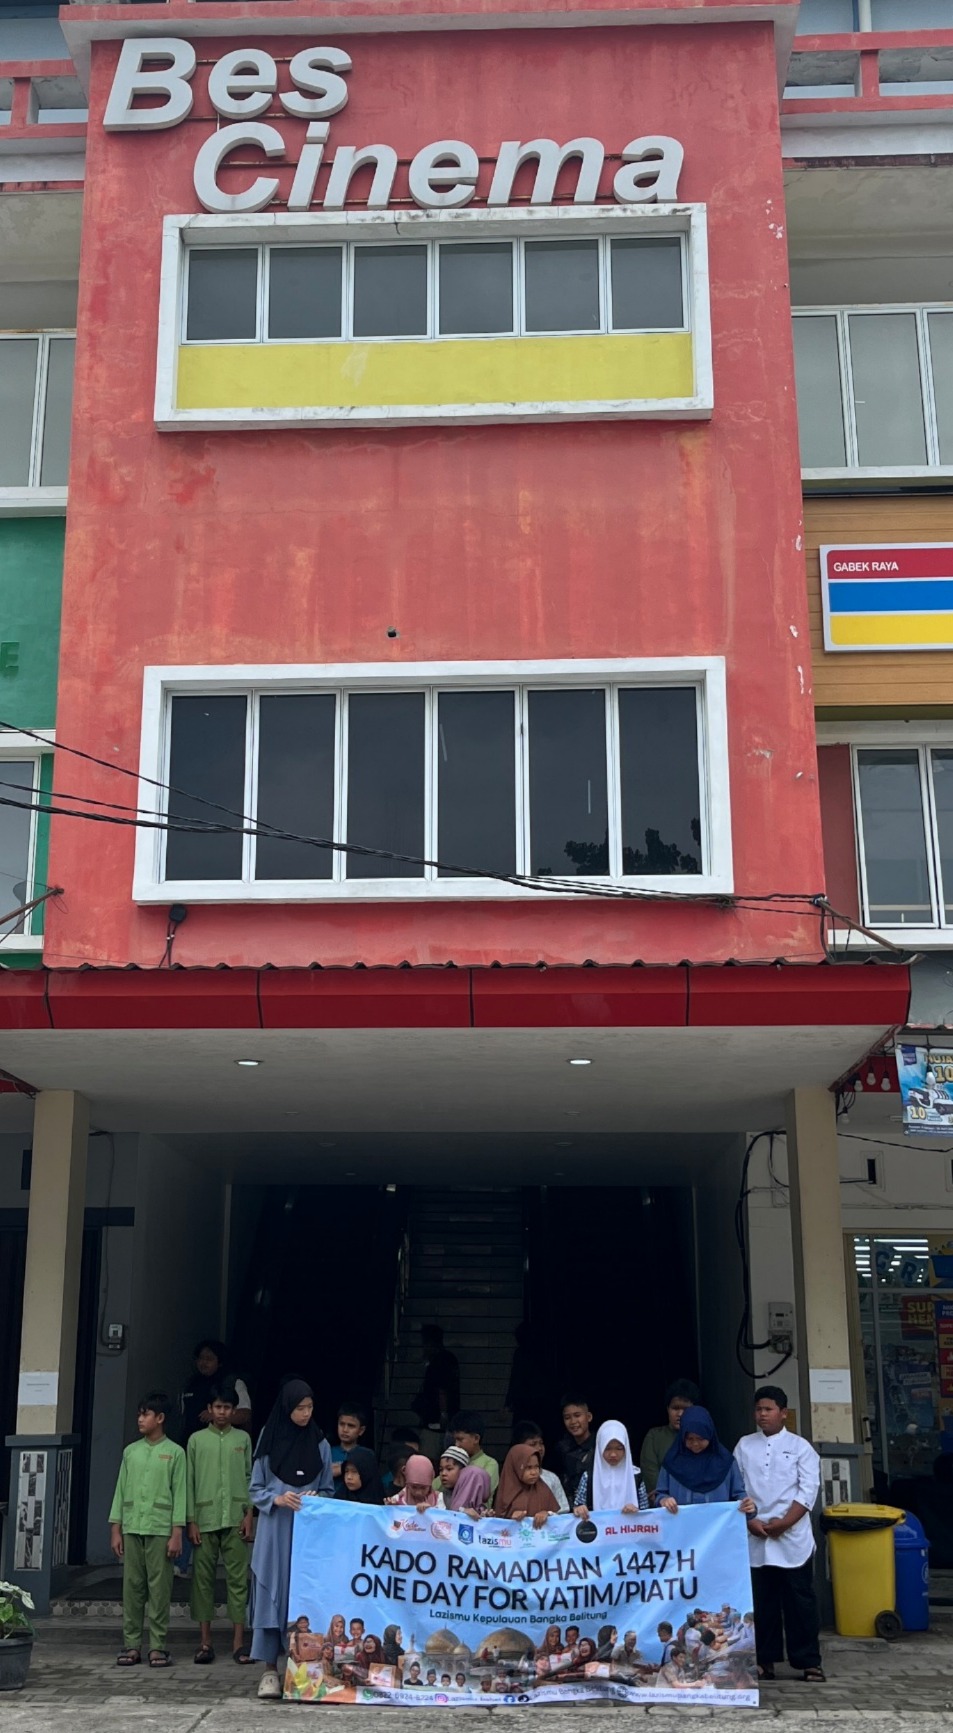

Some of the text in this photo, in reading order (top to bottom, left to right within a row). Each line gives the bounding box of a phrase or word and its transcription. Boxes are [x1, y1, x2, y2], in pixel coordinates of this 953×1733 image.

[103, 37, 352, 132] Bes
[193, 121, 685, 213] Cinema
[833, 561, 899, 572] GABEK RAYA
[911, 1106, 926, 1119] 10
[605, 1527, 618, 1535] AL
[620, 1525, 659, 1534] HIJRAH
[361, 1544, 695, 1583] KADO RAMADHAN 1447 H
[351, 1573, 698, 1611] ONE DAY FOR YATIM/PIATU
[429, 1609, 608, 1625] Lazismu Kepulauan Bangka Belitung
